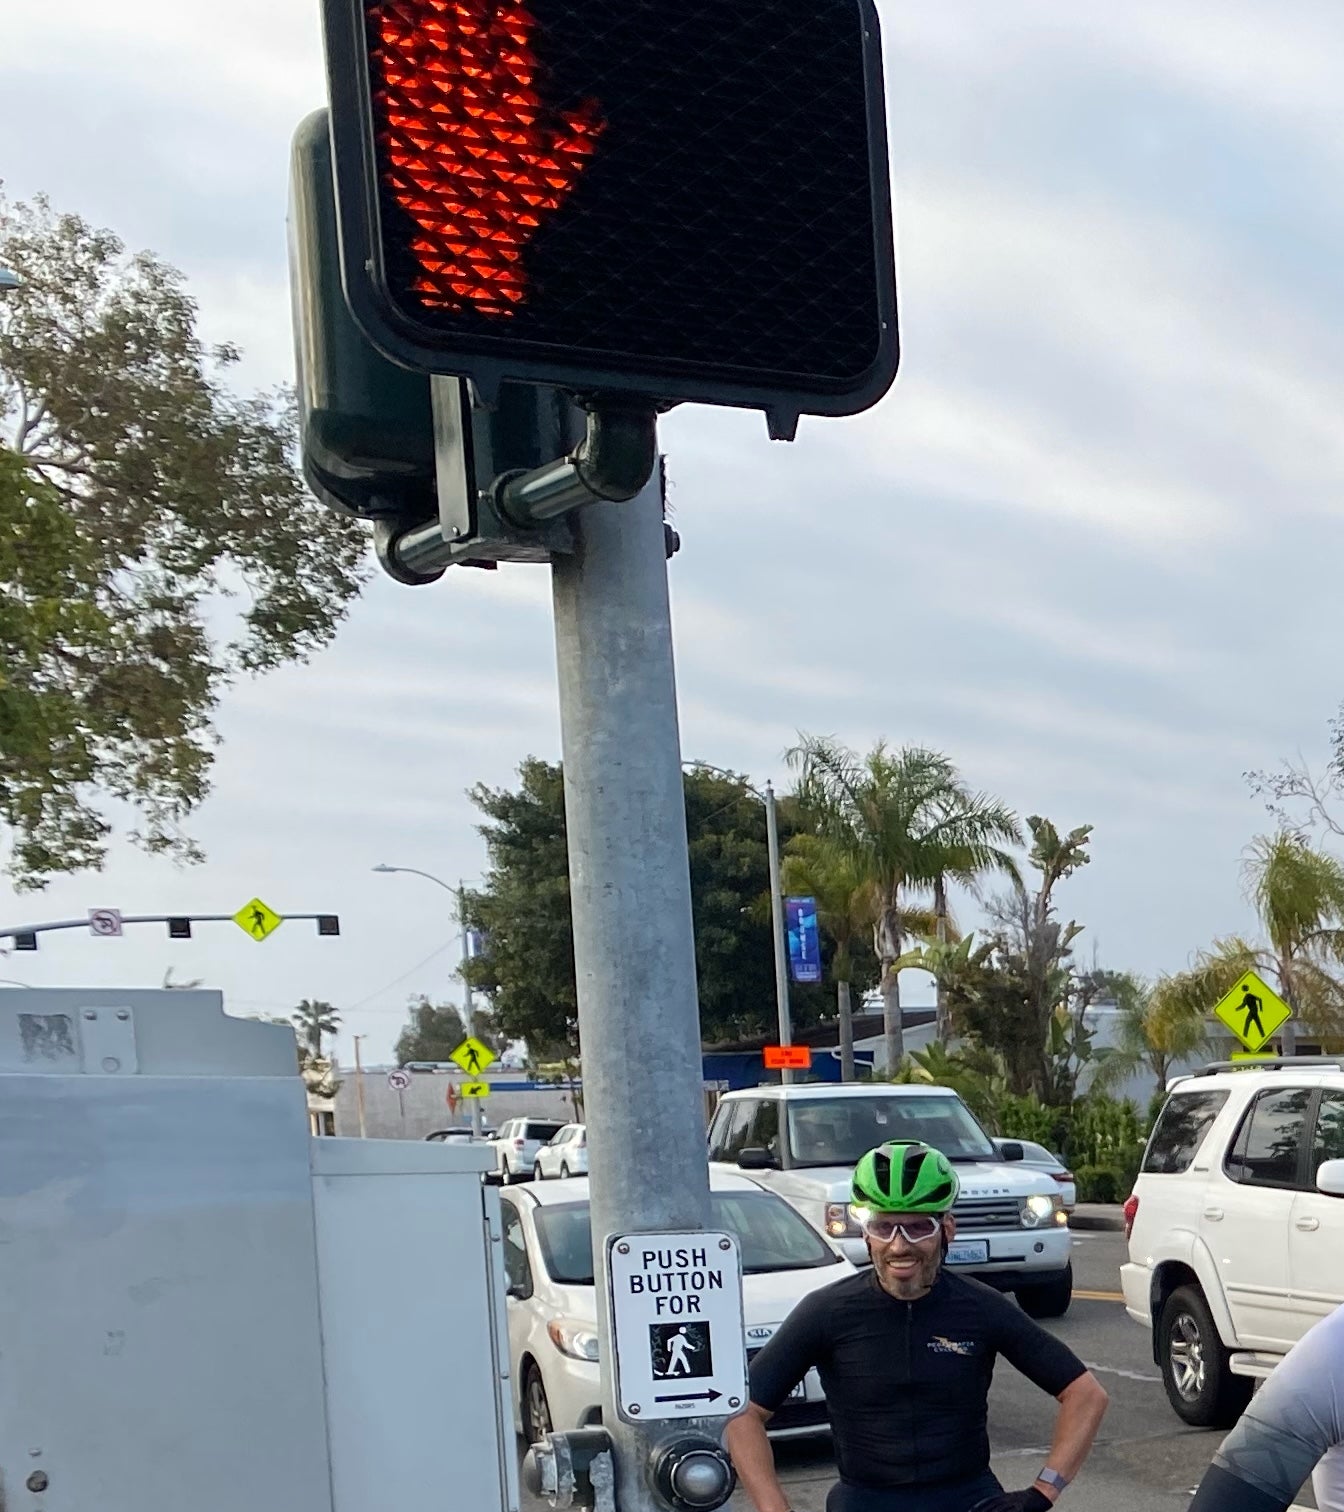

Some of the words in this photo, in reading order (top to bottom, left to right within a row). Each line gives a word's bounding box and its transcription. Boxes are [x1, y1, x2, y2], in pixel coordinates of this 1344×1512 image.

[643, 1248, 707, 1270] PUSH
[629, 1270, 723, 1294] BUTTON
[655, 1294, 701, 1315] FOR
